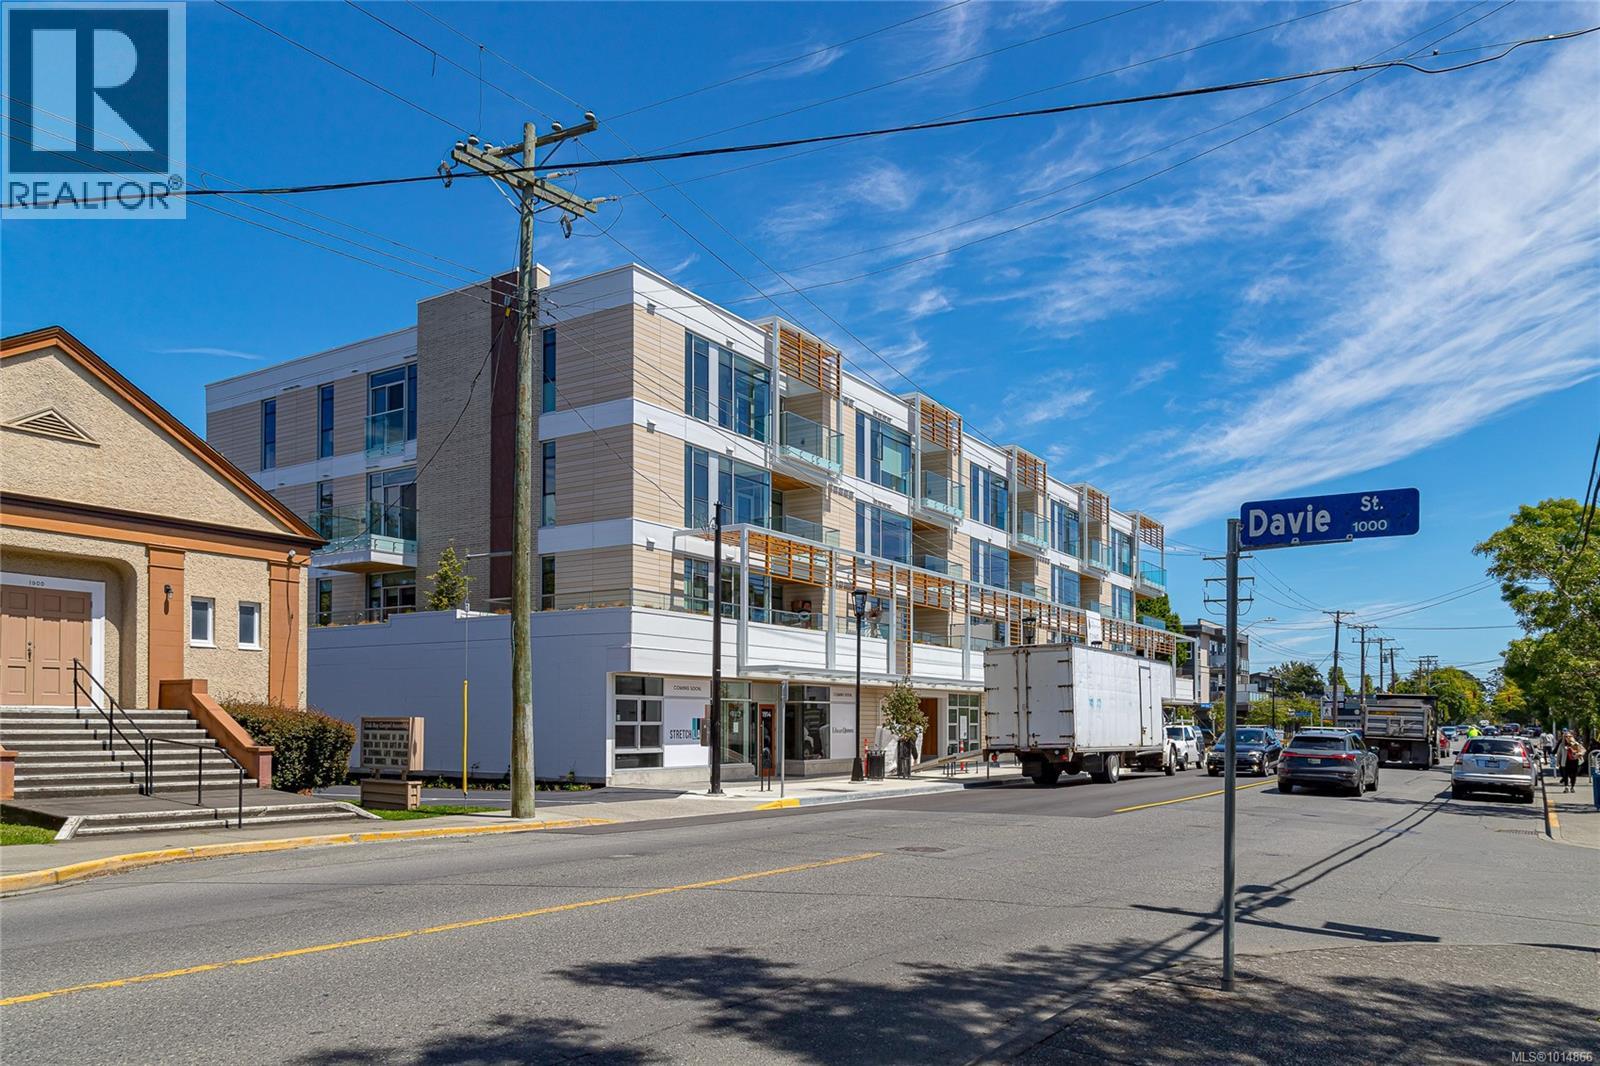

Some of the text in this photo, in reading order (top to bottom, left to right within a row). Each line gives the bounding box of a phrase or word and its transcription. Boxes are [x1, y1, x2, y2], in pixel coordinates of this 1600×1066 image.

[1249, 495, 1384, 538] Davie St.
[1352, 519, 1388, 533] 1000
